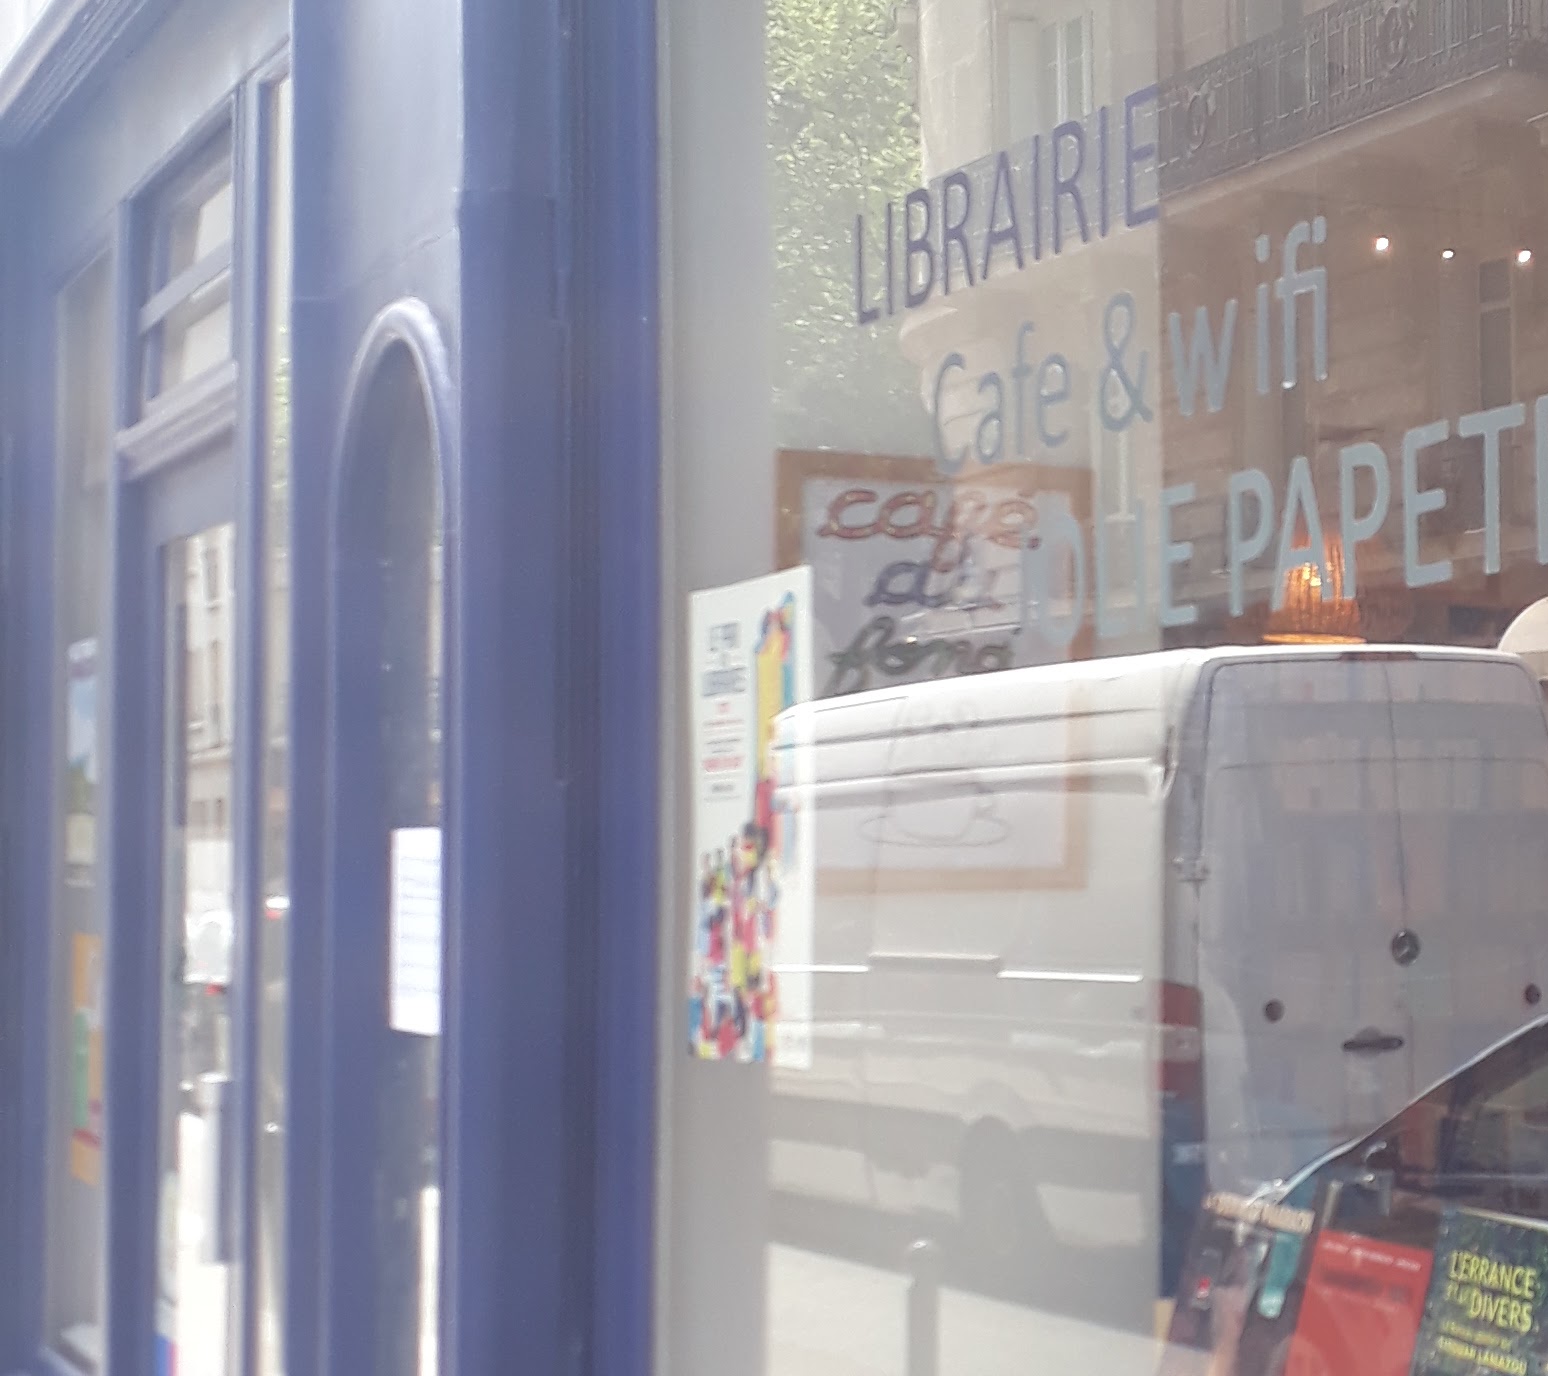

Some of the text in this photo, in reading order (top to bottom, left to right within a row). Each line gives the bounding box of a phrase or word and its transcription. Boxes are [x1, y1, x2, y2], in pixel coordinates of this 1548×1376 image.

[856, 83, 1162, 324] LIBRAIRIE
[1101, 291, 1153, 432] &
[1468, 1286, 1533, 1333] DIVERS
